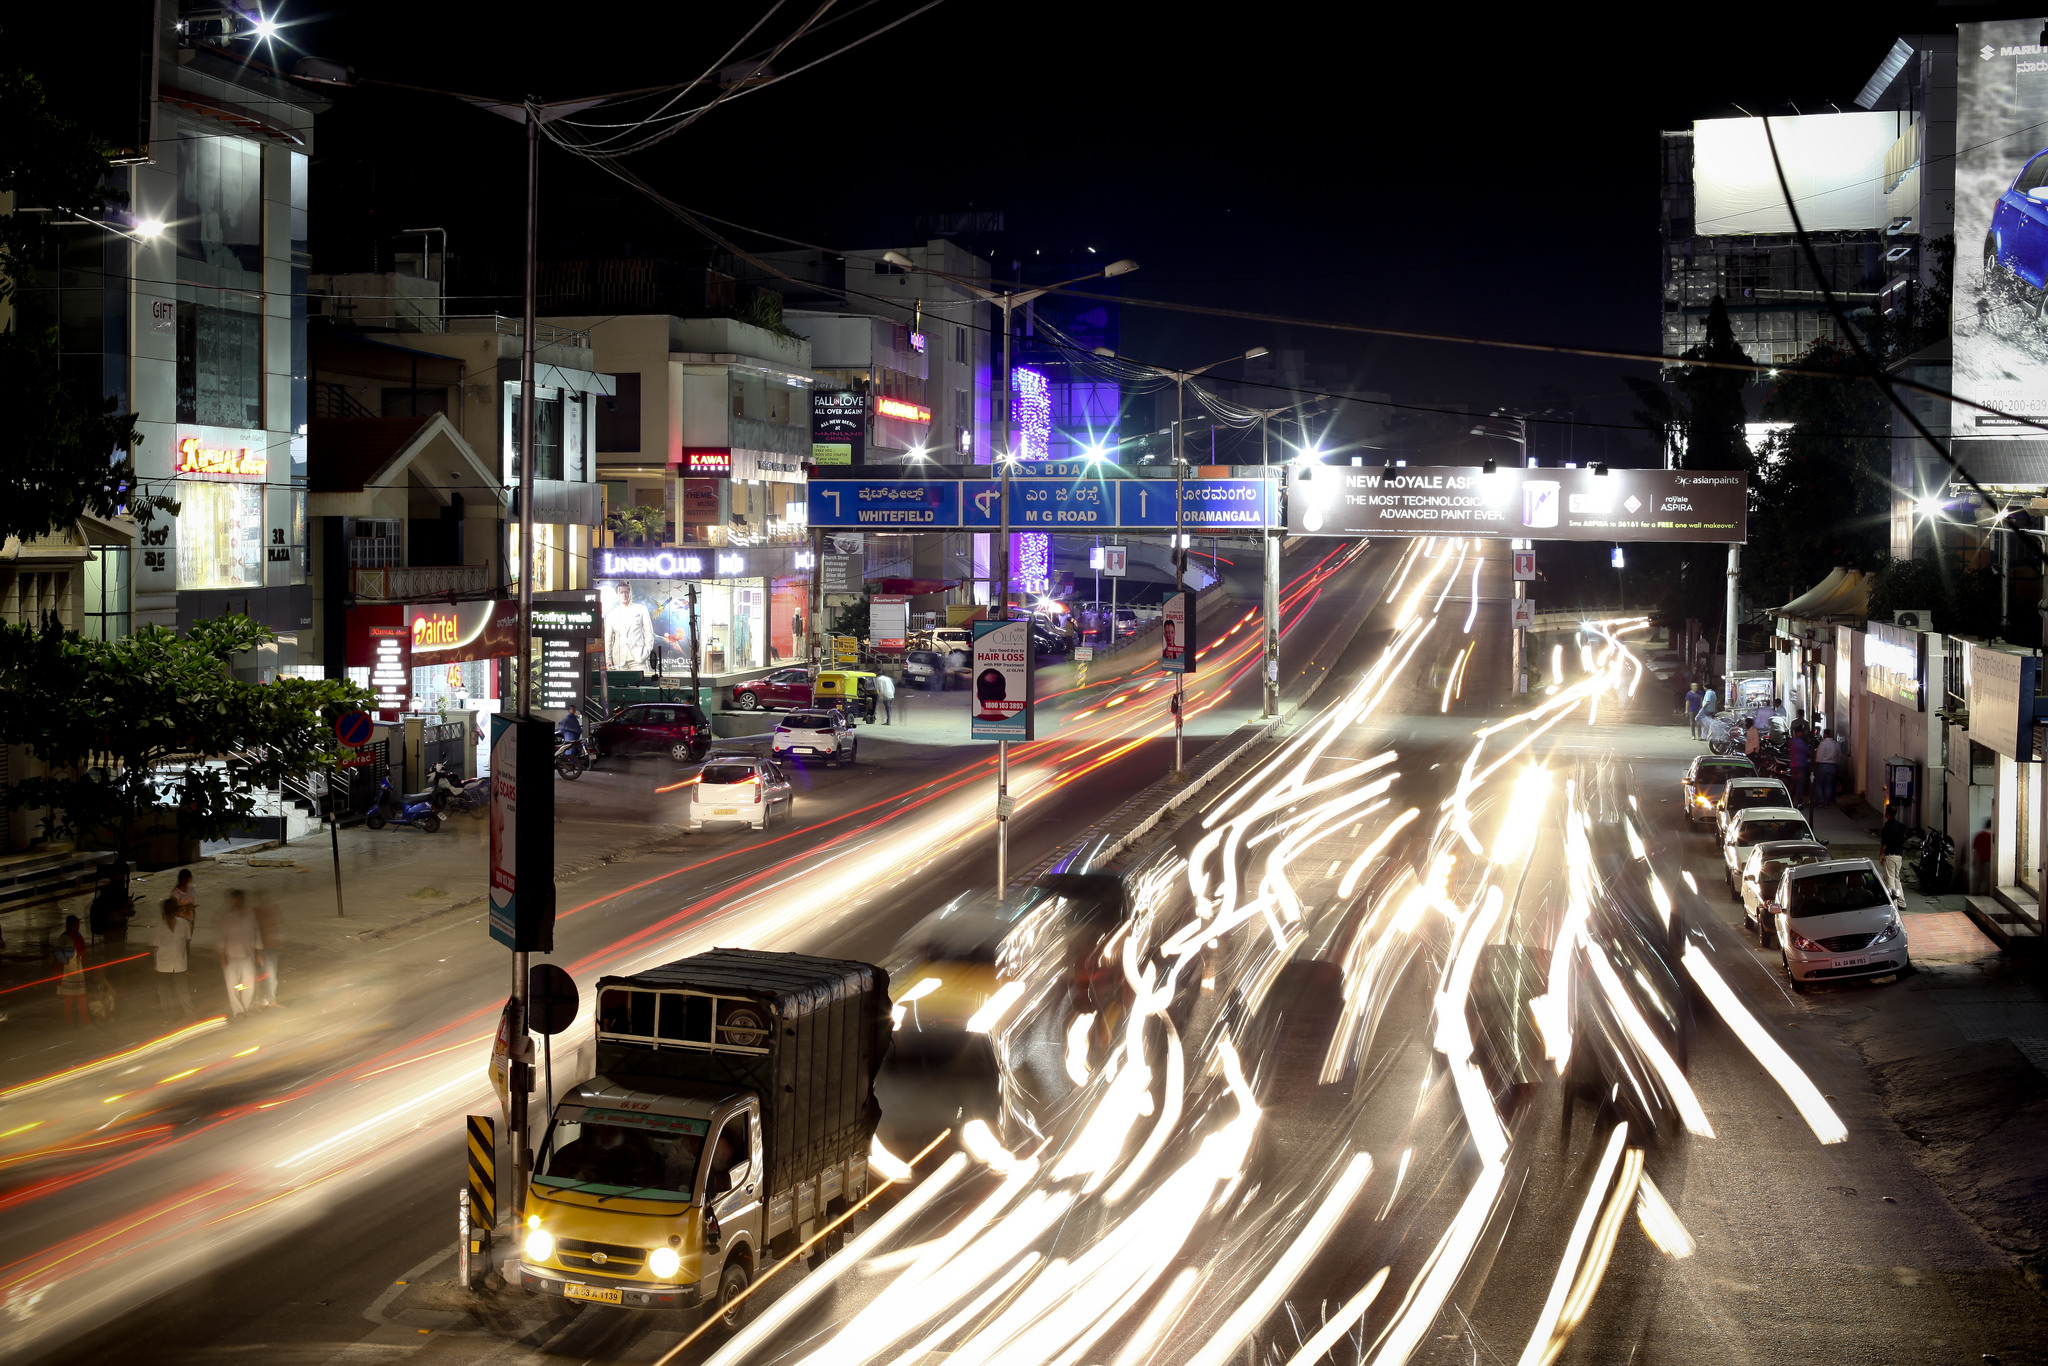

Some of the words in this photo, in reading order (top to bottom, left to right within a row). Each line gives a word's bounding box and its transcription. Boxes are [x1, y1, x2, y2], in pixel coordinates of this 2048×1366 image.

[152, 302, 172, 319] GIFT
[814, 396, 835, 406] FALL
[840, 396, 864, 406] LOVE
[842, 420, 857, 428] MENU
[690, 455, 729, 465] KAWAI
[1345, 476, 1380, 489] NEW
[1384, 475, 1443, 490] ROYALE
[1692, 475, 1739, 487] asianpaints
[685, 491, 712, 499] THEME
[1345, 495, 1367, 506] THE
[1369, 496, 1401, 506] MOST
[1665, 495, 1689, 504] royale
[1660, 503, 1694, 513] ASPIRA
[858, 510, 935, 522] WHITEFIELD
[1026, 511, 1038, 522] M
[1042, 511, 1053, 522] G
[1057, 511, 1098, 522] ROAD
[1379, 508, 1438, 520] ADVANCED
[1441, 509, 1472, 520] PAINT
[1474, 510, 1505, 521] EVER.
[1689, 521, 1702, 529] wall
[272, 528, 286, 544] 3R
[267, 549, 291, 562] PLAZA
[531, 611, 566, 625] Floating
[567, 612, 593, 623] walls
[425, 613, 459, 645] airtel
[977, 652, 1000, 661] HAIR
[1001, 653, 1025, 662] LOSS
[447, 665, 462, 688] 4G
[499, 780, 517, 802] SCARS
[581, 1288, 591, 1297] 53
[591, 1290, 599, 1298] A
[600, 1291, 618, 1301] 1139
